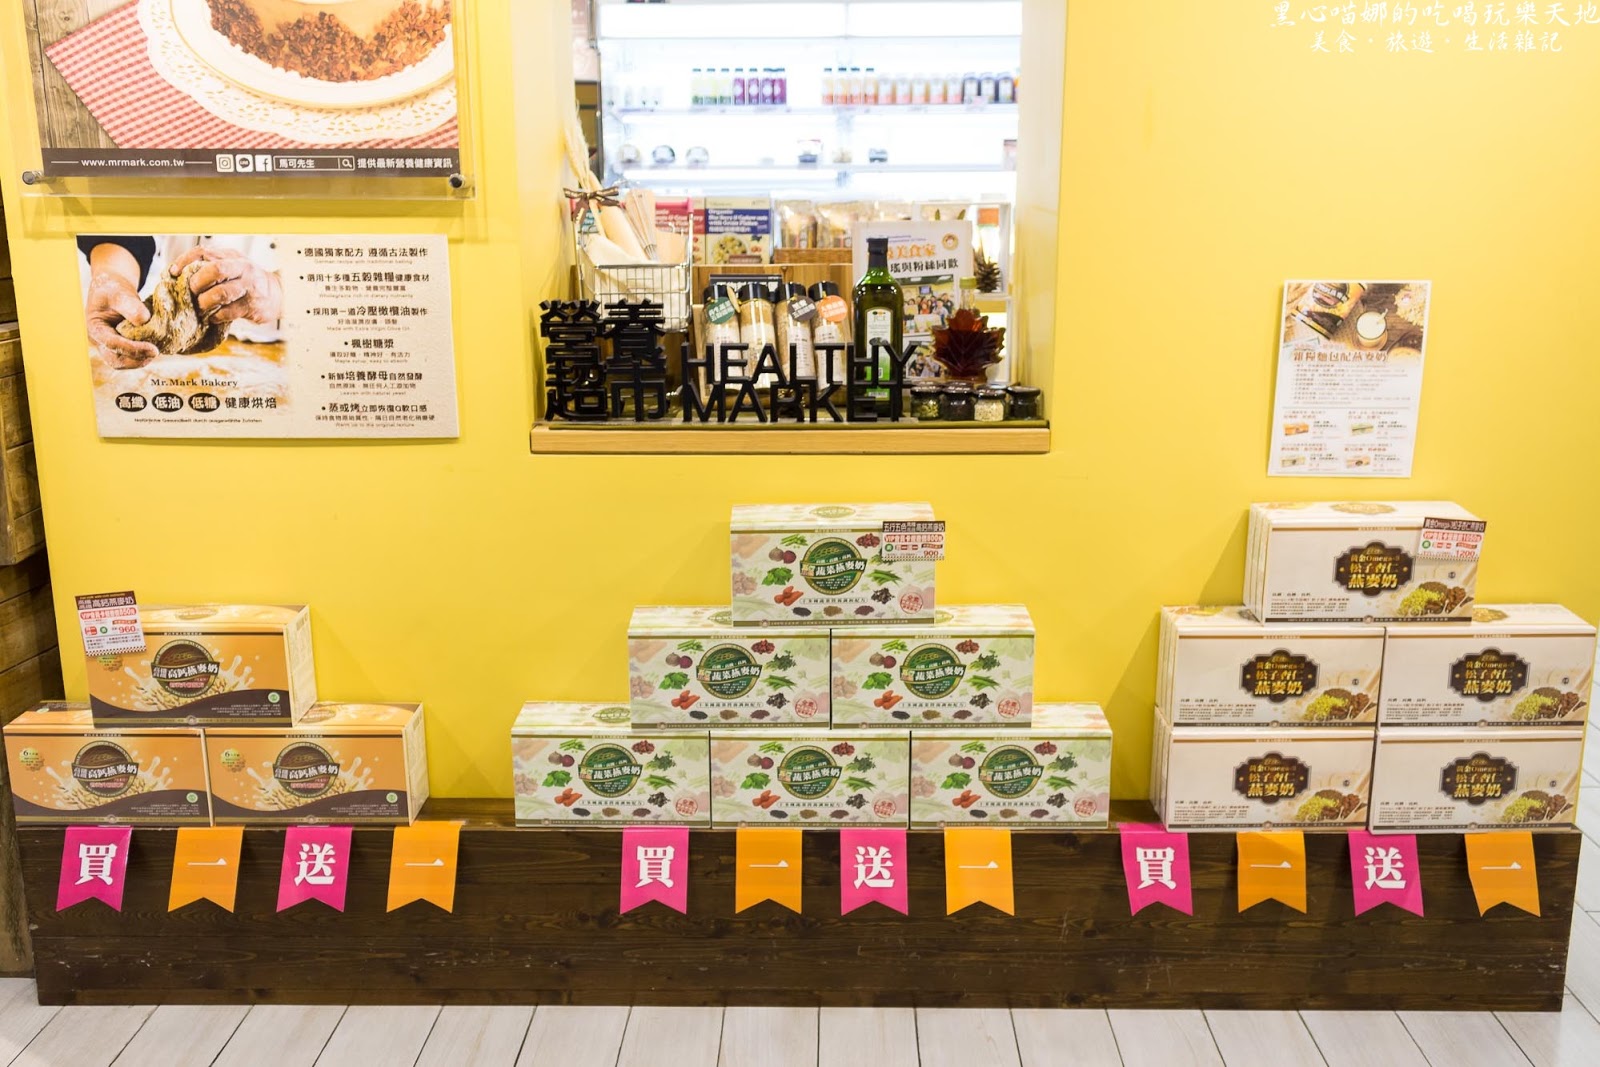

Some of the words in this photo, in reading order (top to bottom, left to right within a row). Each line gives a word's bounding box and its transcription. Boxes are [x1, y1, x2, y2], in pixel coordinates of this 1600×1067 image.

[82, 158, 186, 167] www.mrmark.com.tw
[281, 159, 316, 169] 馬可先生
[358, 158, 454, 169] 提供最新營養健康資訊
[304, 248, 364, 257] 德國獨家配方
[681, 341, 922, 385] HEALTHY
[201, 378, 238, 388] Bakery
[154, 396, 180, 409] 低油
[191, 396, 217, 409] 低糖
[225, 397, 277, 409] 健康烘焙
[683, 381, 913, 422] MARKET
[1348, 573, 1398, 588] 燕麥奶
[1254, 681, 1303, 695] 燕麥奶
[1463, 680, 1512, 694] 燕麥奶
[1248, 783, 1295, 796] 燕麥奶
[1454, 783, 1501, 797] 燕麥奶
[76, 843, 119, 886] 買
[189, 857, 228, 866] 一
[295, 842, 337, 887] 送
[406, 857, 446, 866] 一
[635, 845, 675, 889] 買
[749, 859, 789, 868] 一
[853, 845, 895, 890] 送
[959, 860, 999, 869] 一
[1135, 846, 1177, 890] 買
[1250, 860, 1291, 869] 一
[1363, 845, 1407, 890] 送
[1480, 860, 1521, 870] 一
